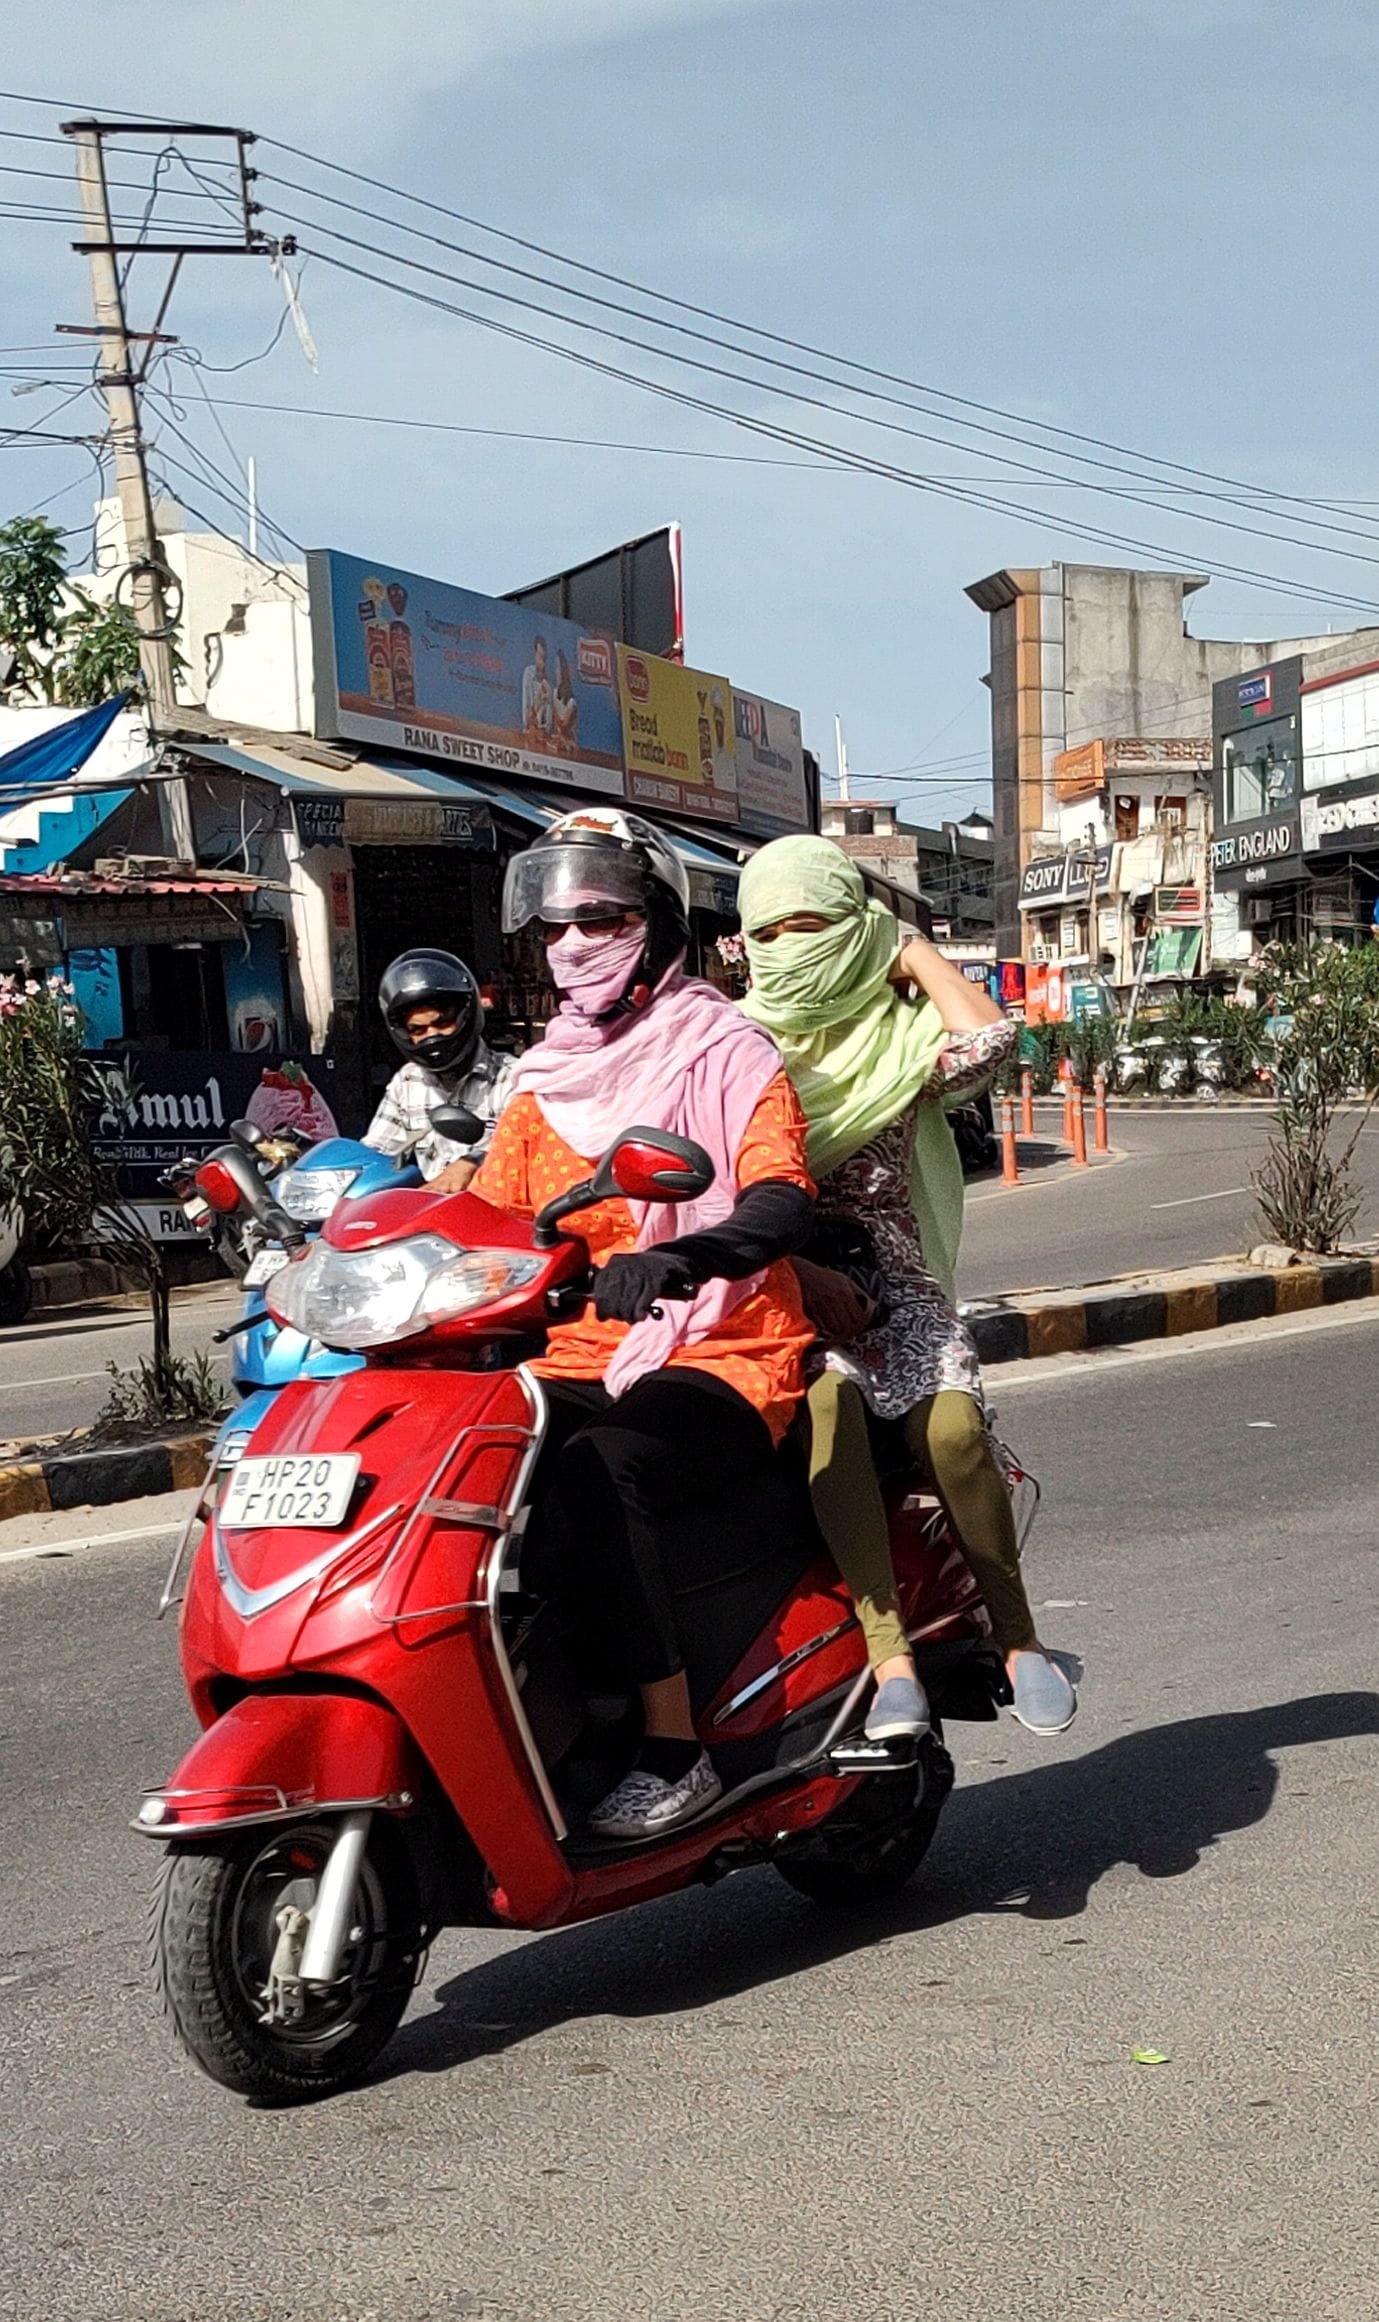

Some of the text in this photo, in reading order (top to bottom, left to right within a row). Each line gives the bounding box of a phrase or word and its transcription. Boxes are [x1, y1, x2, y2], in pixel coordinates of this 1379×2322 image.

[629, 708, 658, 736] Bread
[403, 727, 520, 769] RANA SWEET SHOP
[1211, 825, 1290, 867] PETER ENGLAND
[1023, 865, 1064, 893] SONY
[1069, 856, 1109, 887] LLOD
[100, 1070, 226, 1136] Amul
[260, 1460, 332, 1488] HP20
[241, 1492, 332, 1521] F1023
